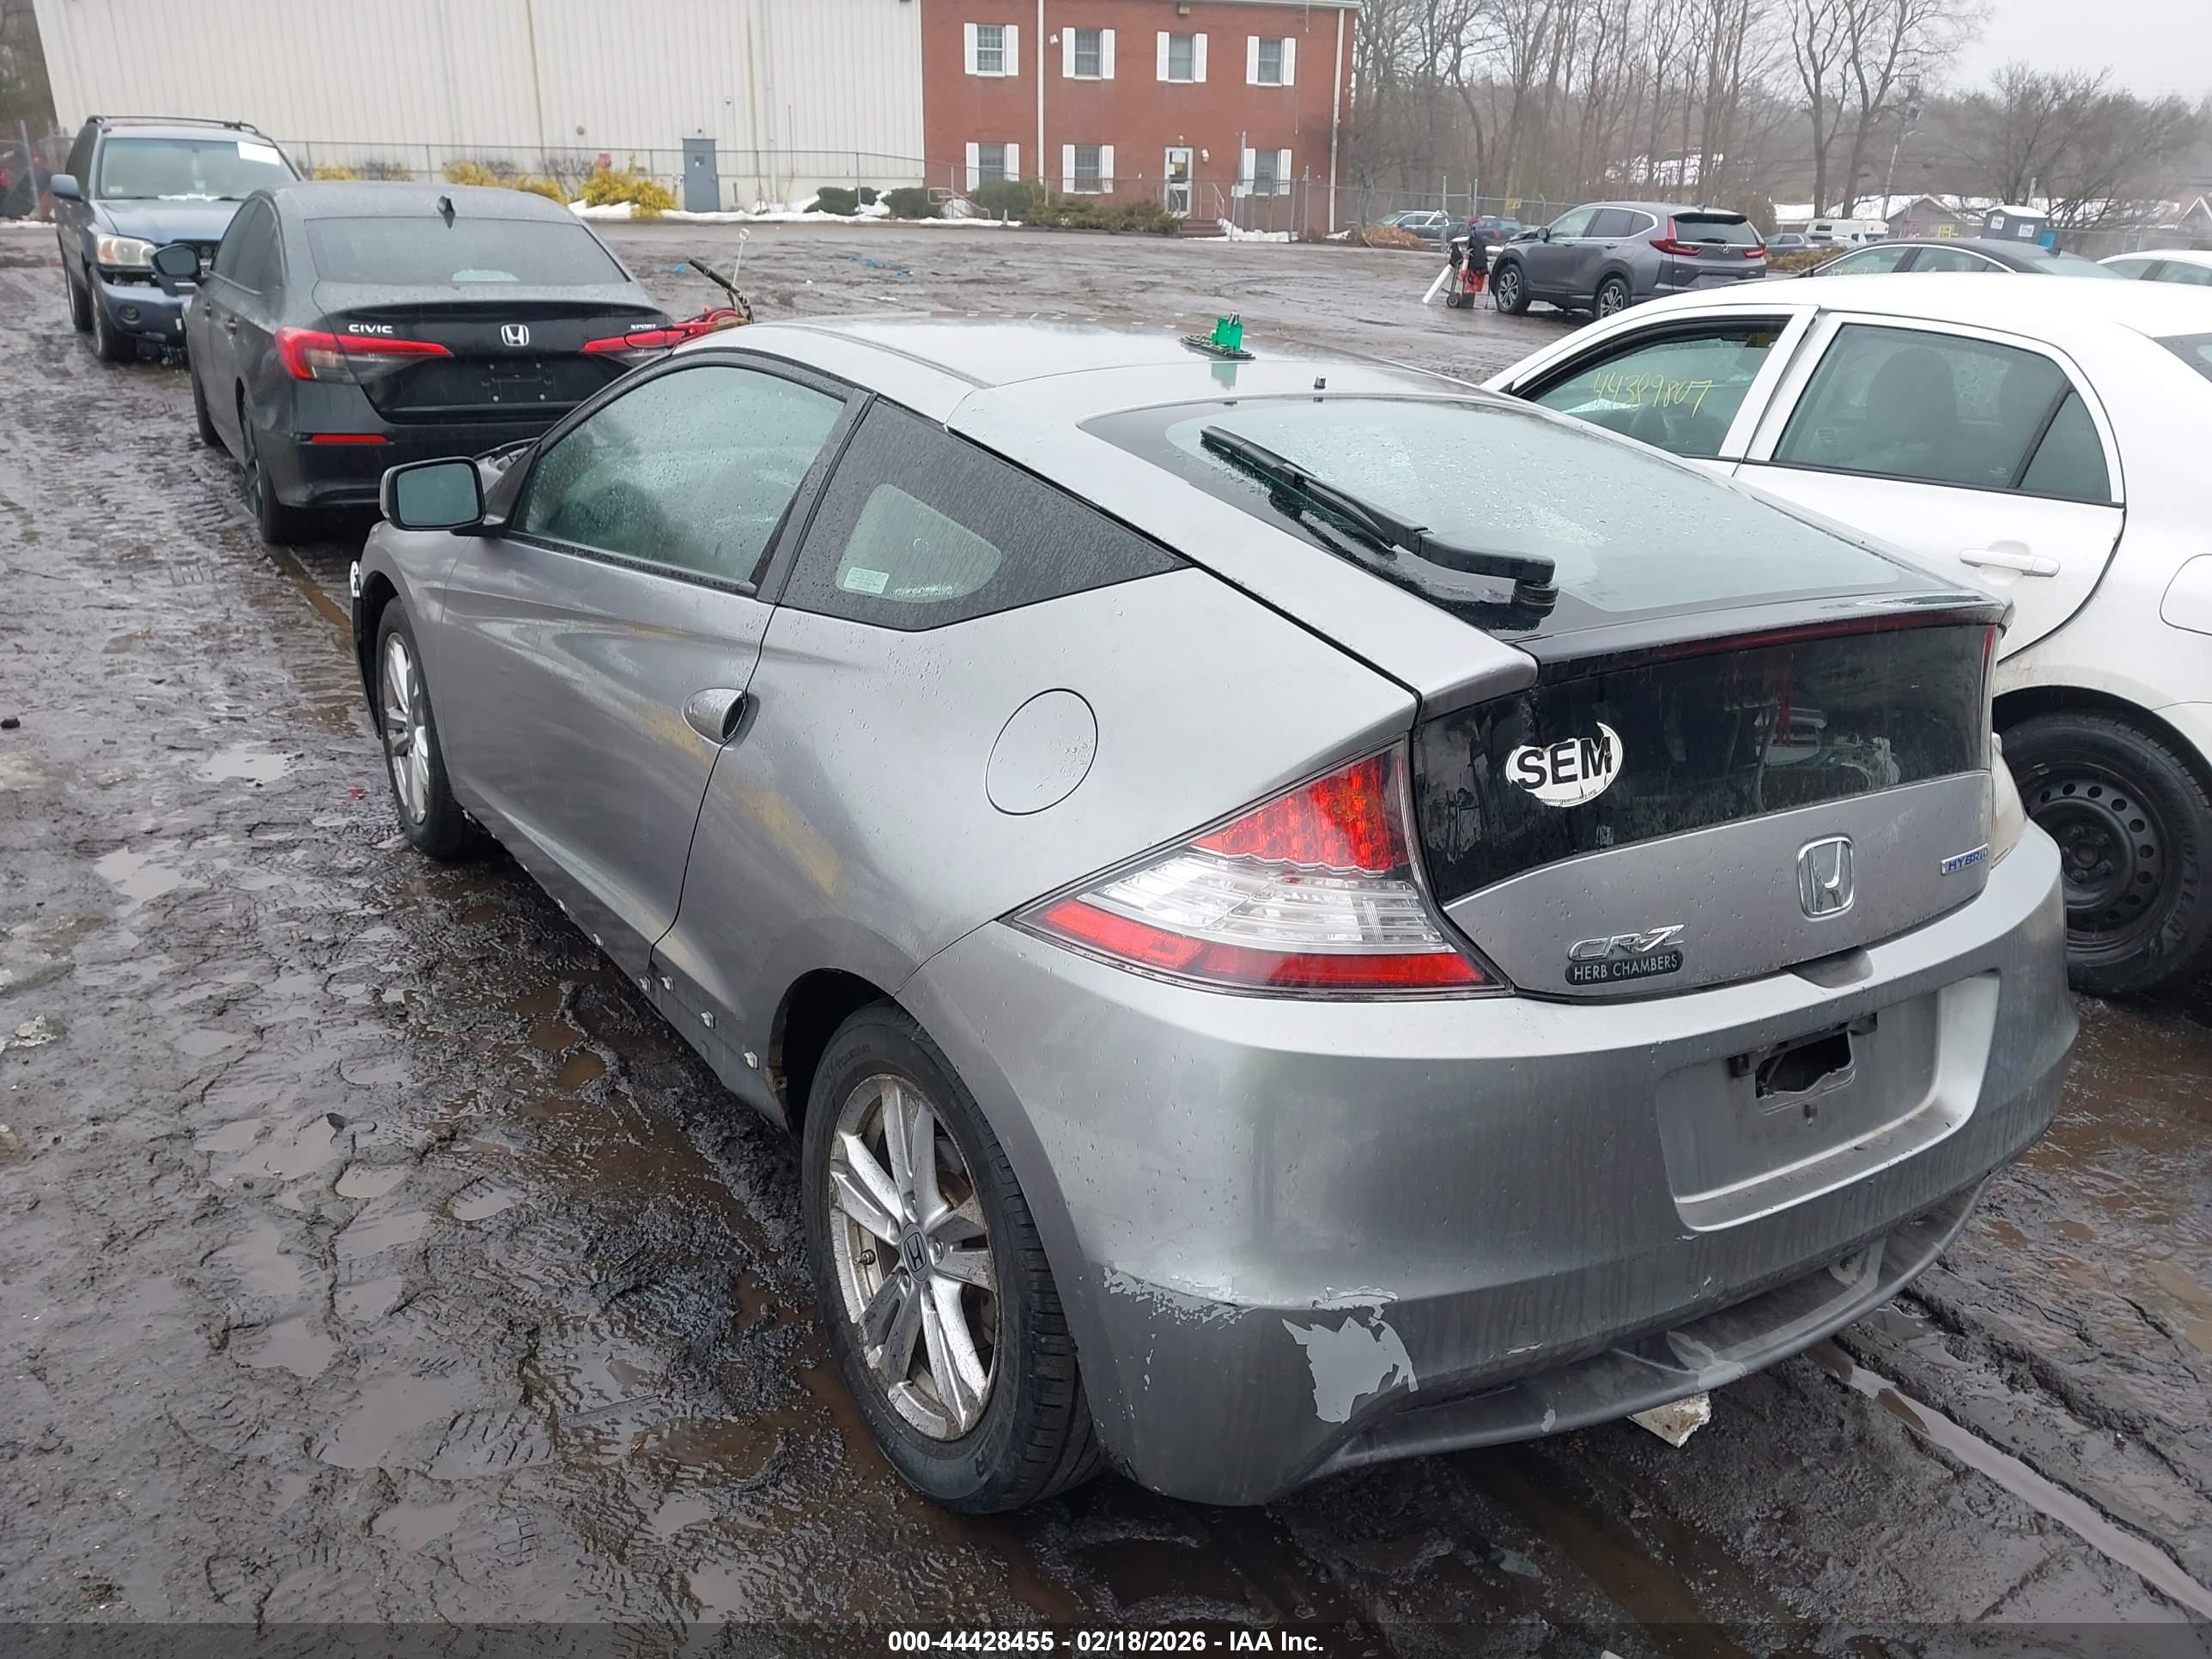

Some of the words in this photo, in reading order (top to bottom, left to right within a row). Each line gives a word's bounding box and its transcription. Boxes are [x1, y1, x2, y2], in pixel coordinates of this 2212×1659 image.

[348, 324, 393, 333] CIVIC
[1516, 736, 1613, 790] SEM
[1948, 847, 1989, 872] HYBRID
[1574, 965, 1608, 981] HERB
[1613, 954, 1677, 976] CHAMBERS
